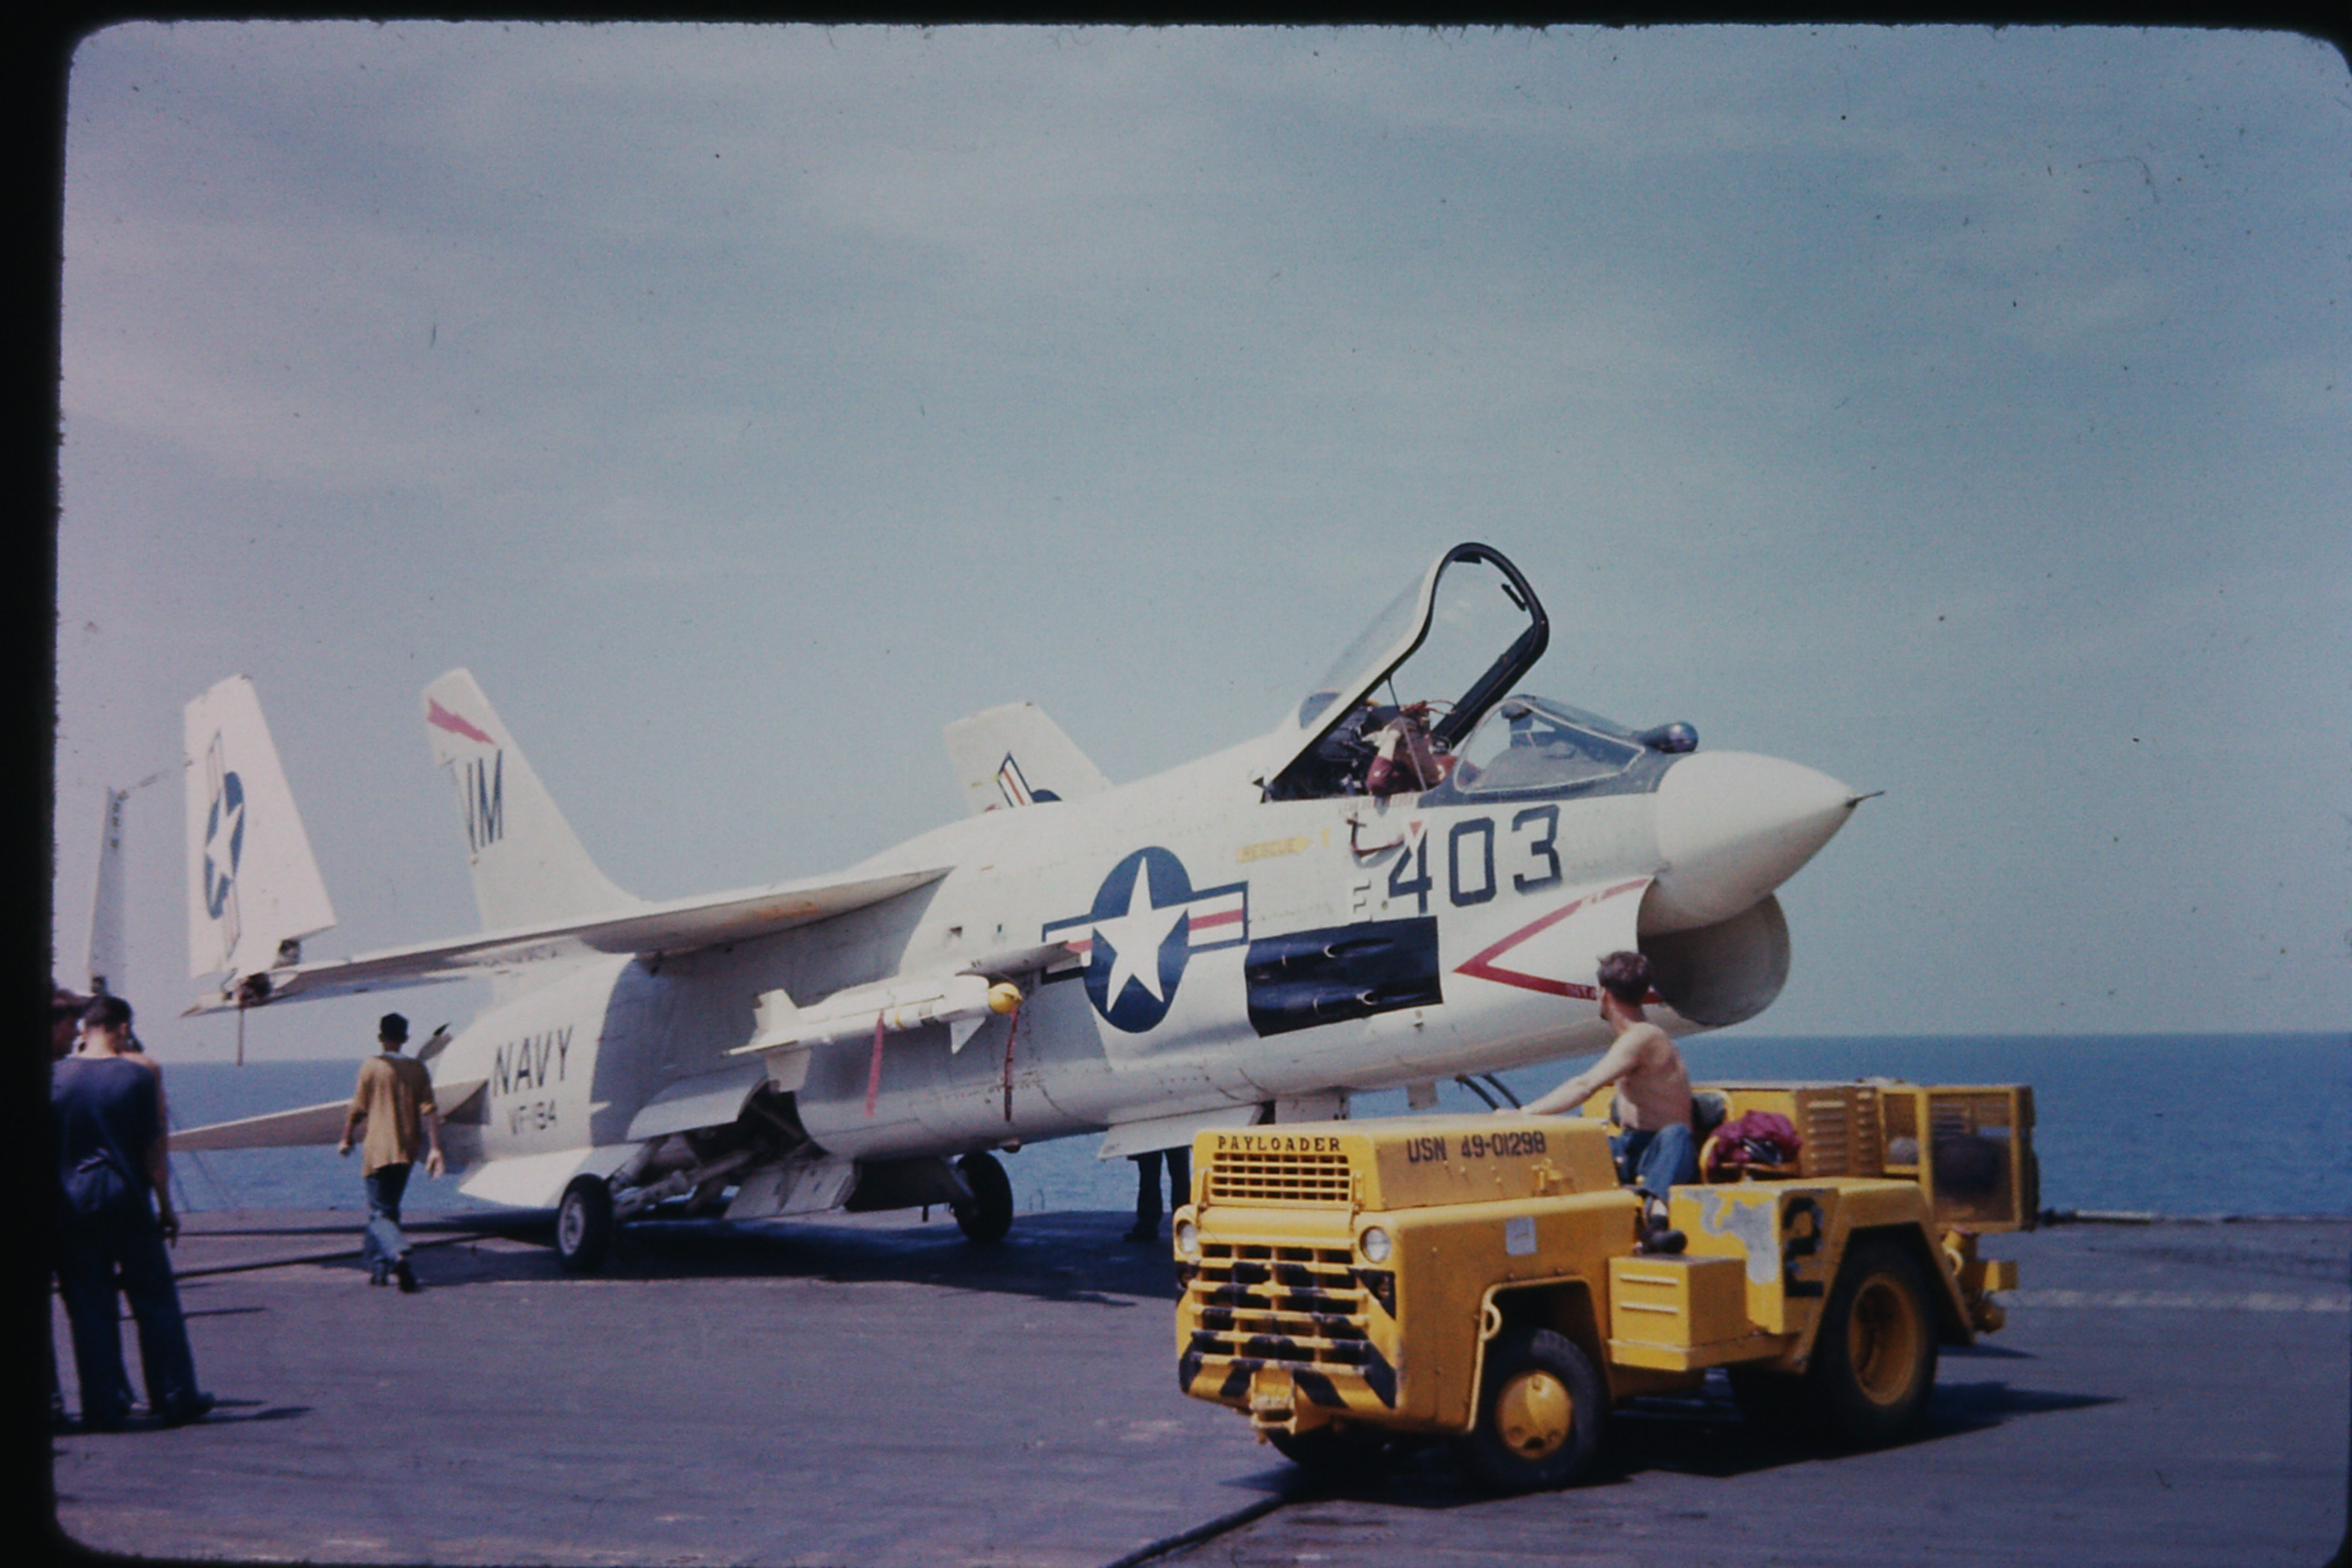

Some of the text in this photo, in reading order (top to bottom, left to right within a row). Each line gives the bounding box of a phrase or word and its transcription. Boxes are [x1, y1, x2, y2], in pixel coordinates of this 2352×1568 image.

[1389, 804, 1563, 915] 403
[493, 1024, 574, 1098] NAVY
[1217, 1135, 1342, 1152] PAYLOADER
[1407, 1131, 1547, 1164] USN 49-01298
[1783, 1197, 1825, 1298] 2
